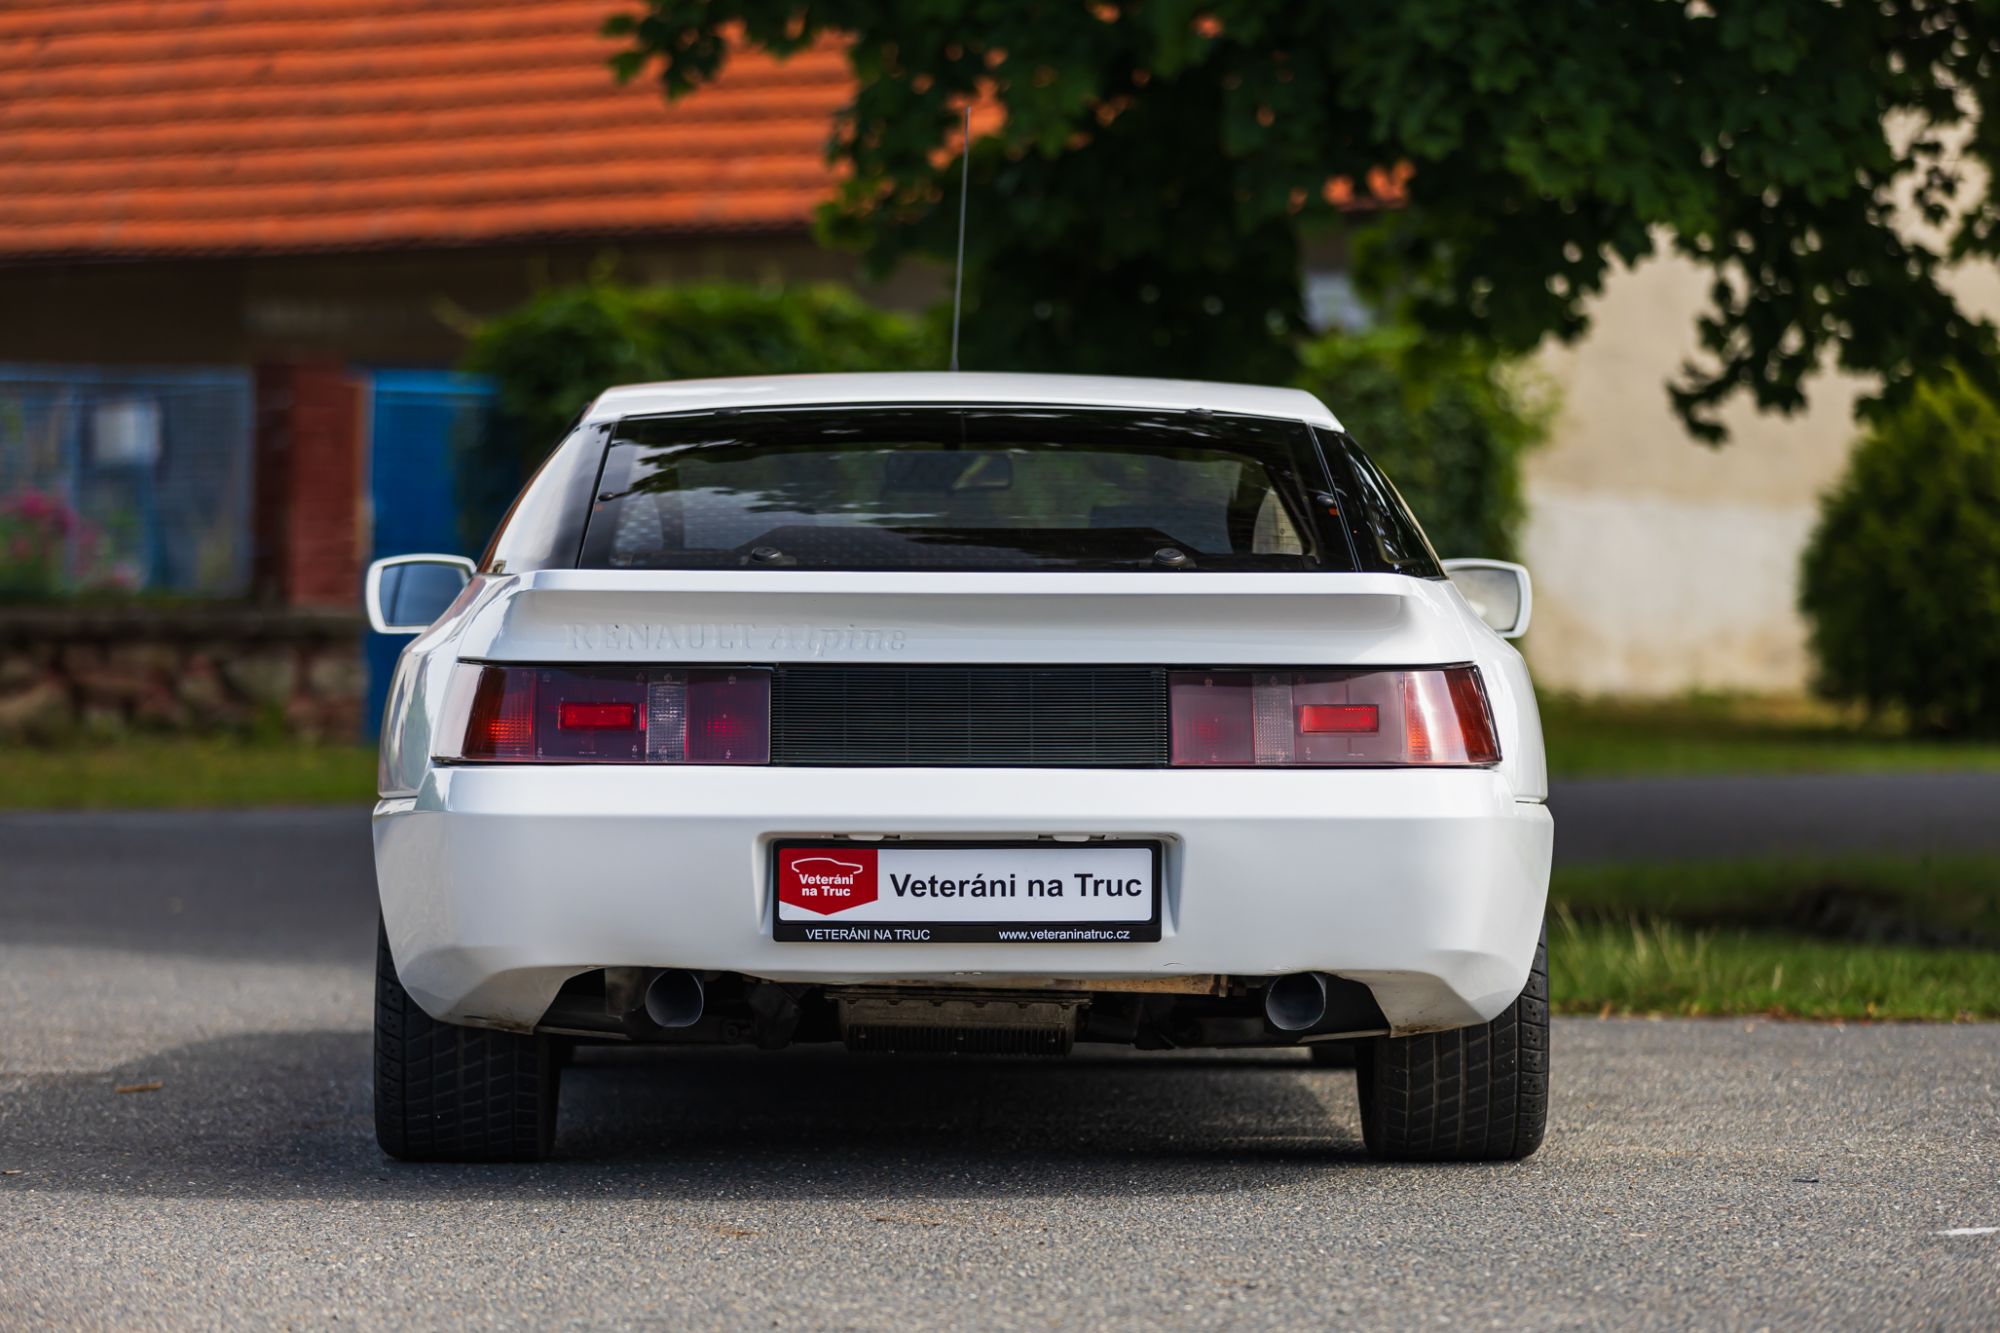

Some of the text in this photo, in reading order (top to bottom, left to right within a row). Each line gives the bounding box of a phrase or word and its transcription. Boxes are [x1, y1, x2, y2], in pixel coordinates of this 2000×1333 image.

[562, 623, 907, 657] RENAULT Alpine
[799, 873, 853, 884] Veteráni
[801, 885, 851, 897] na Truc
[890, 874, 1142, 897] Veteráni na Truc
[806, 928, 931, 940] VETERÁNI NA TRUC
[998, 929, 1130, 940] www.veteraninatruc.cz
